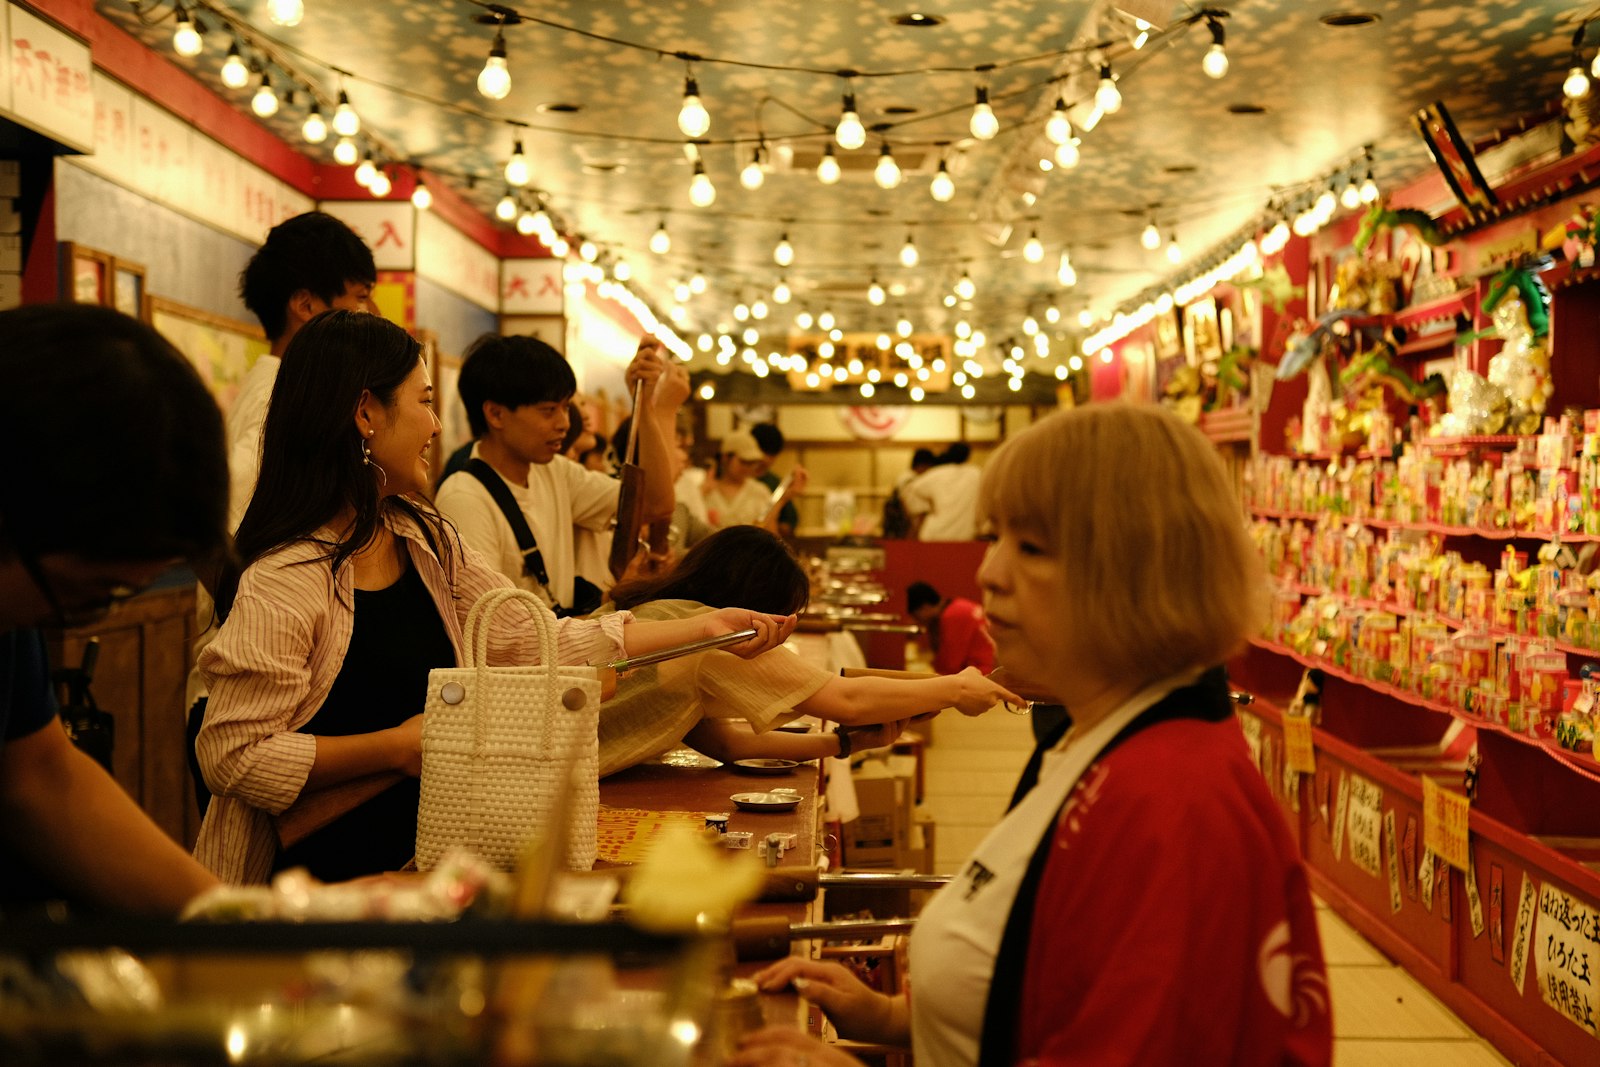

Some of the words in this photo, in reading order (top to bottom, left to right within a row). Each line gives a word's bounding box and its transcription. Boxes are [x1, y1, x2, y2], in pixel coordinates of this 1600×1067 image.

[1548, 934, 1591, 986] ひろた玉
[1548, 972, 1597, 1030] 使用禁止
